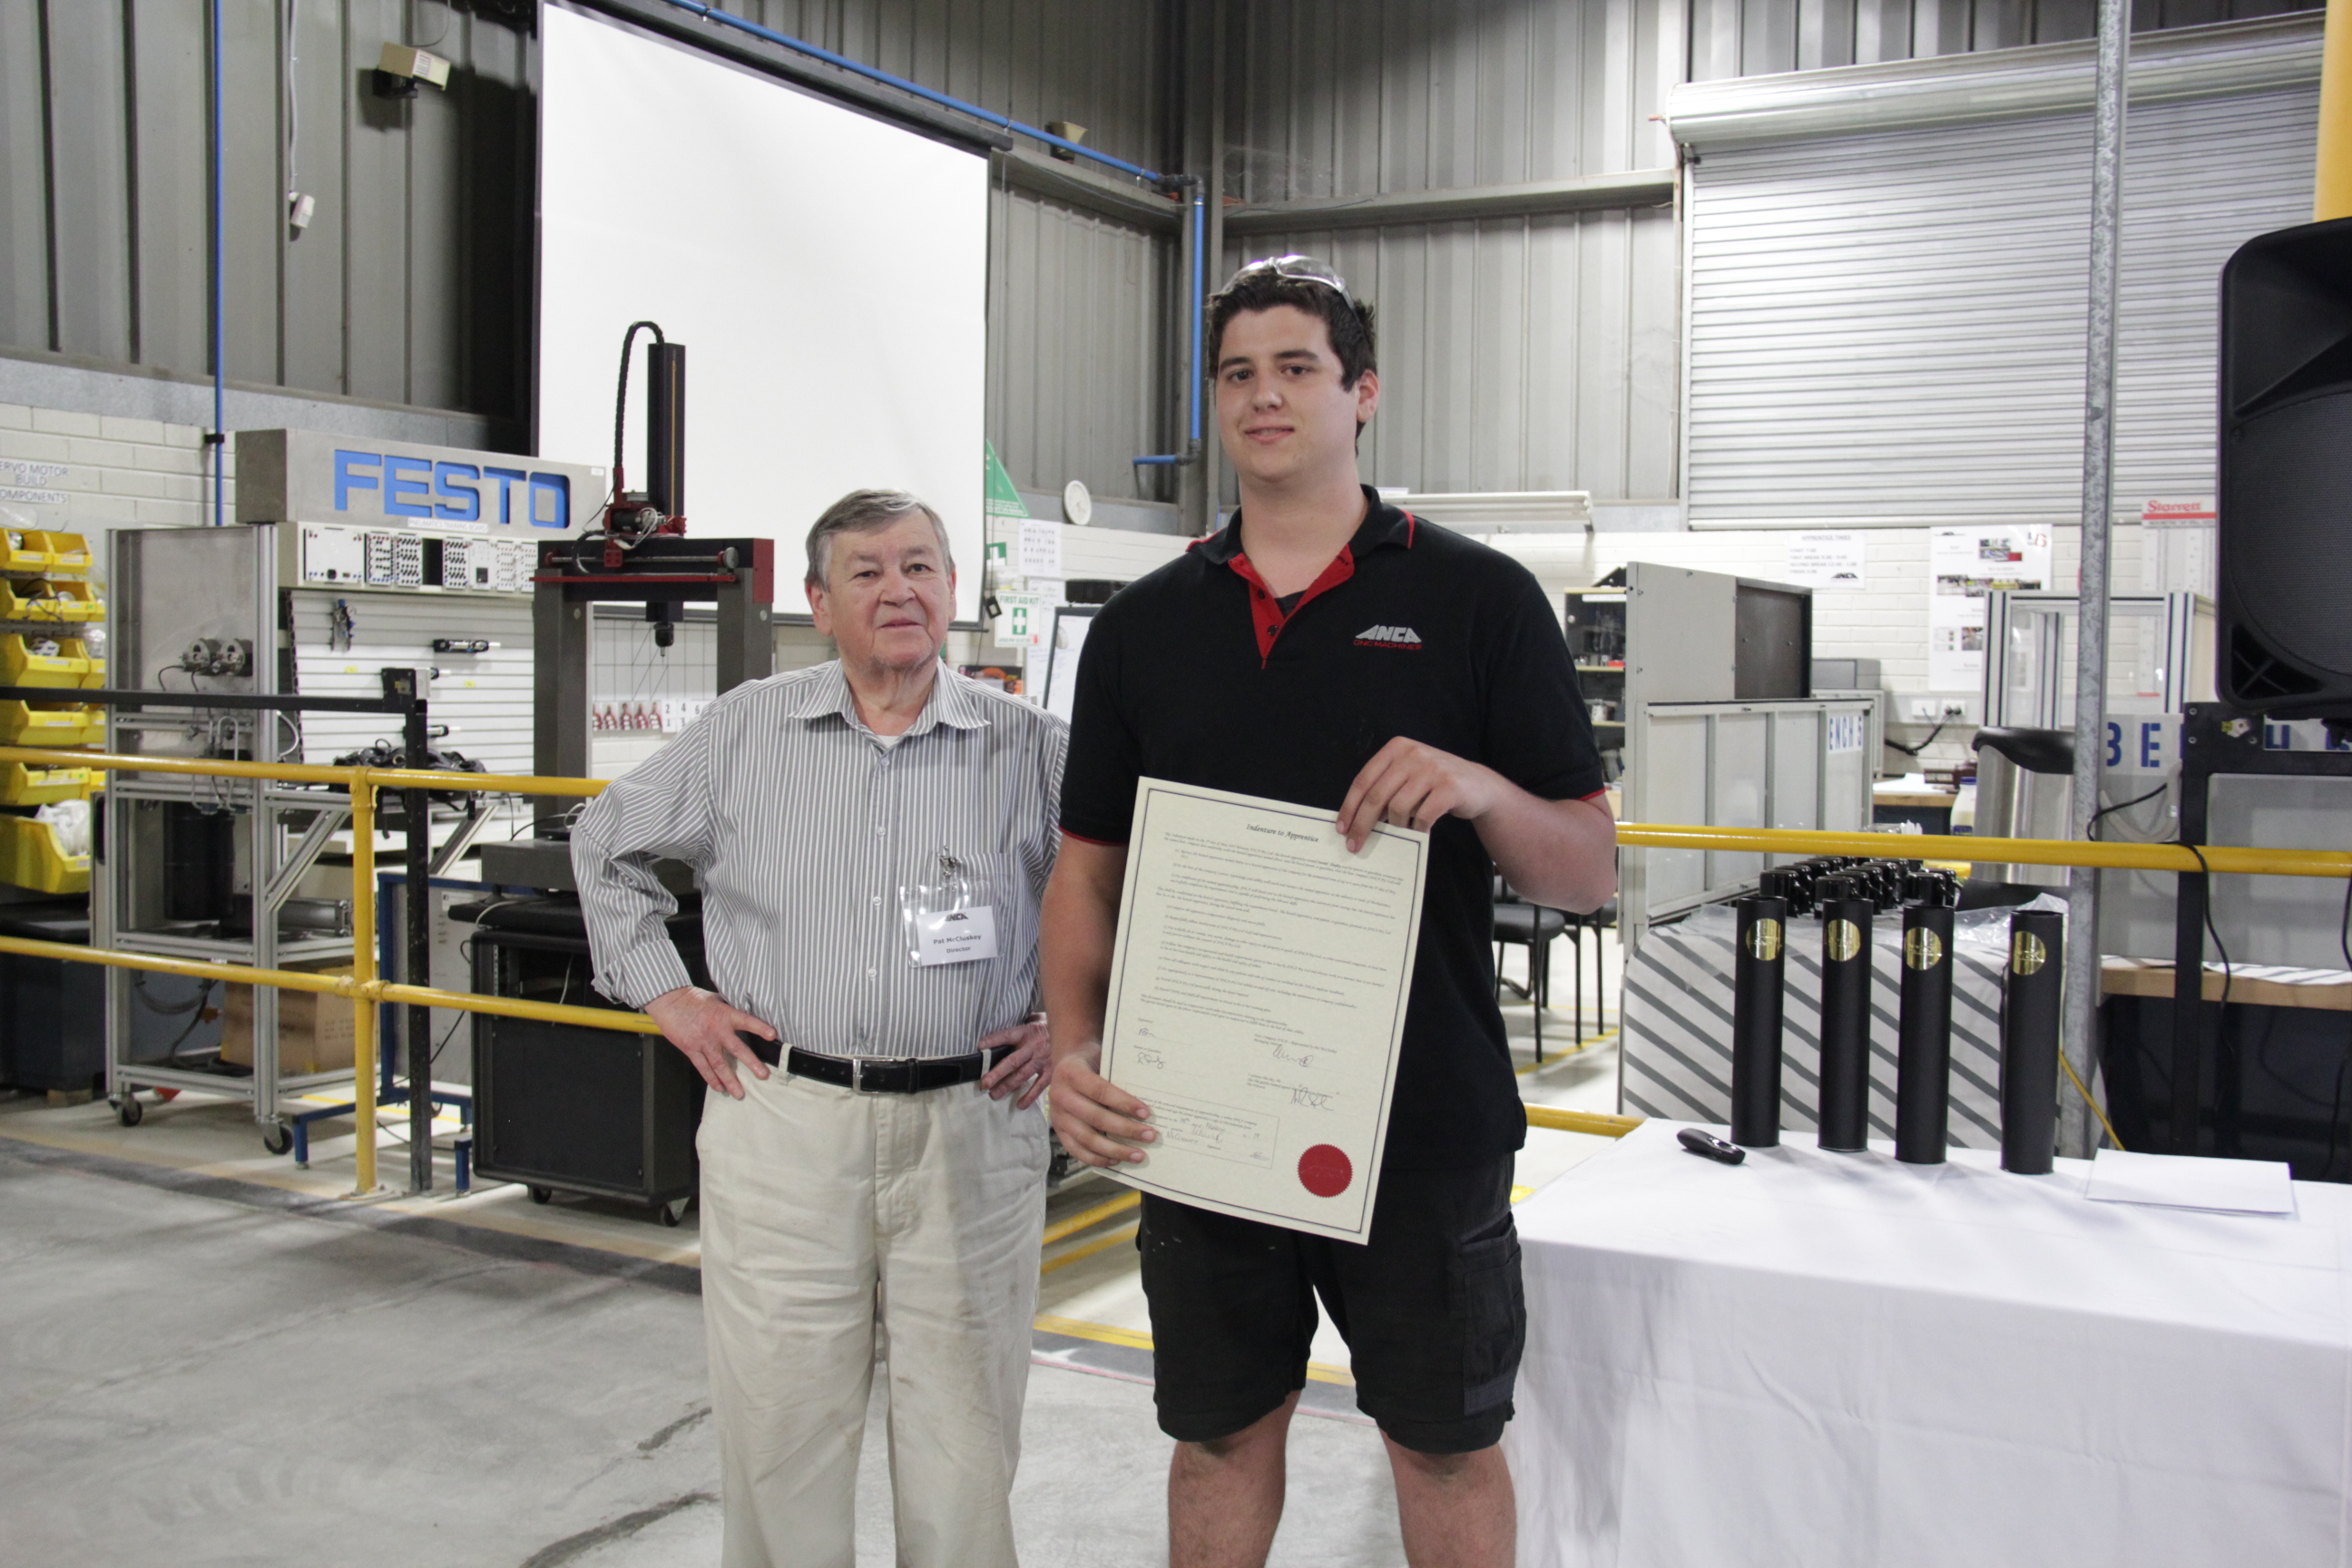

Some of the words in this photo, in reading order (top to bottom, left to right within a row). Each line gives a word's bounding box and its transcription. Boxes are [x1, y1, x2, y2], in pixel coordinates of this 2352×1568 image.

[29, 464, 69, 476] MOTOR
[15, 474, 47, 486] BUILD
[333, 449, 571, 529] FESTO
[999, 595, 1017, 604] FIRST
[1018, 596, 1028, 604] AID
[1029, 597, 1040, 605] KIT
[1355, 624, 1422, 643] ANCA
[1375, 642, 1422, 650] MACHINES
[665, 704, 670, 714] 2
[681, 702, 686, 712] 4
[694, 705, 700, 715] 6
[1246, 823, 1277, 835] Indenture
[1285, 831, 1319, 843] Apprentice
[946, 934, 982, 944] McCluskey
[946, 946, 971, 954] Director
